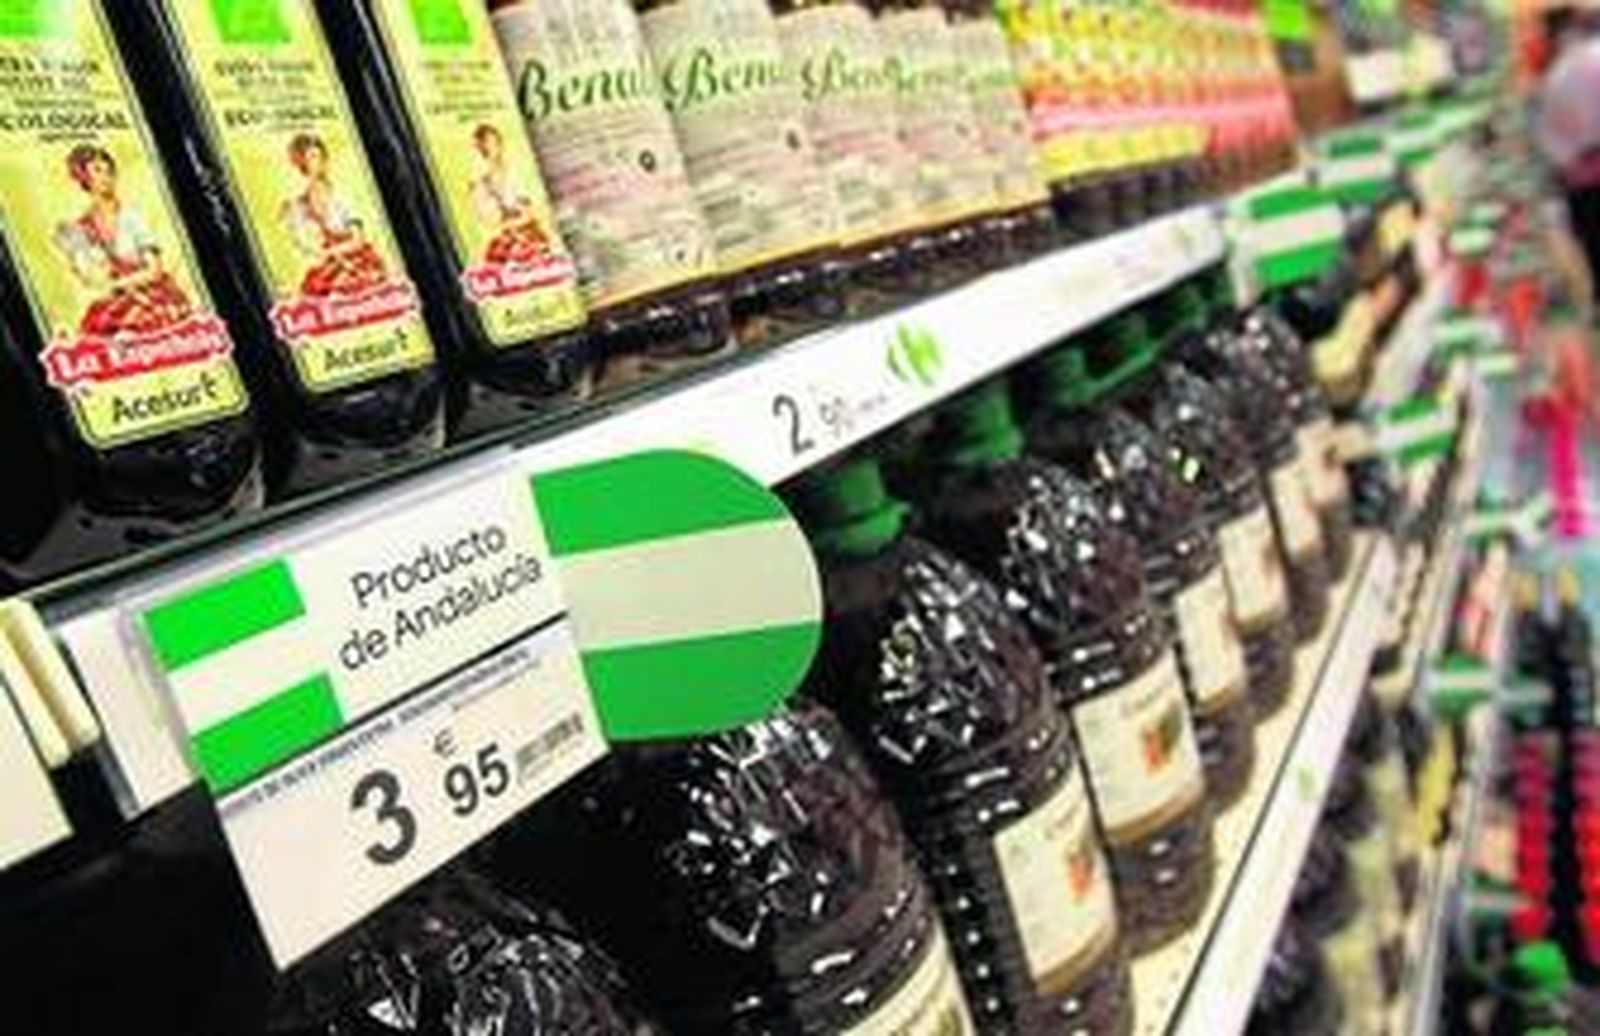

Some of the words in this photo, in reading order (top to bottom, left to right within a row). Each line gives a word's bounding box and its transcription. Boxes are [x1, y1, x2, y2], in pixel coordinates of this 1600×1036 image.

[772, 393, 815, 457] 2
[339, 629, 388, 671] de
[393, 553, 542, 646] Andalucía
[349, 525, 508, 608] Producto
[350, 768, 418, 866] 3
[443, 742, 510, 818] 95
